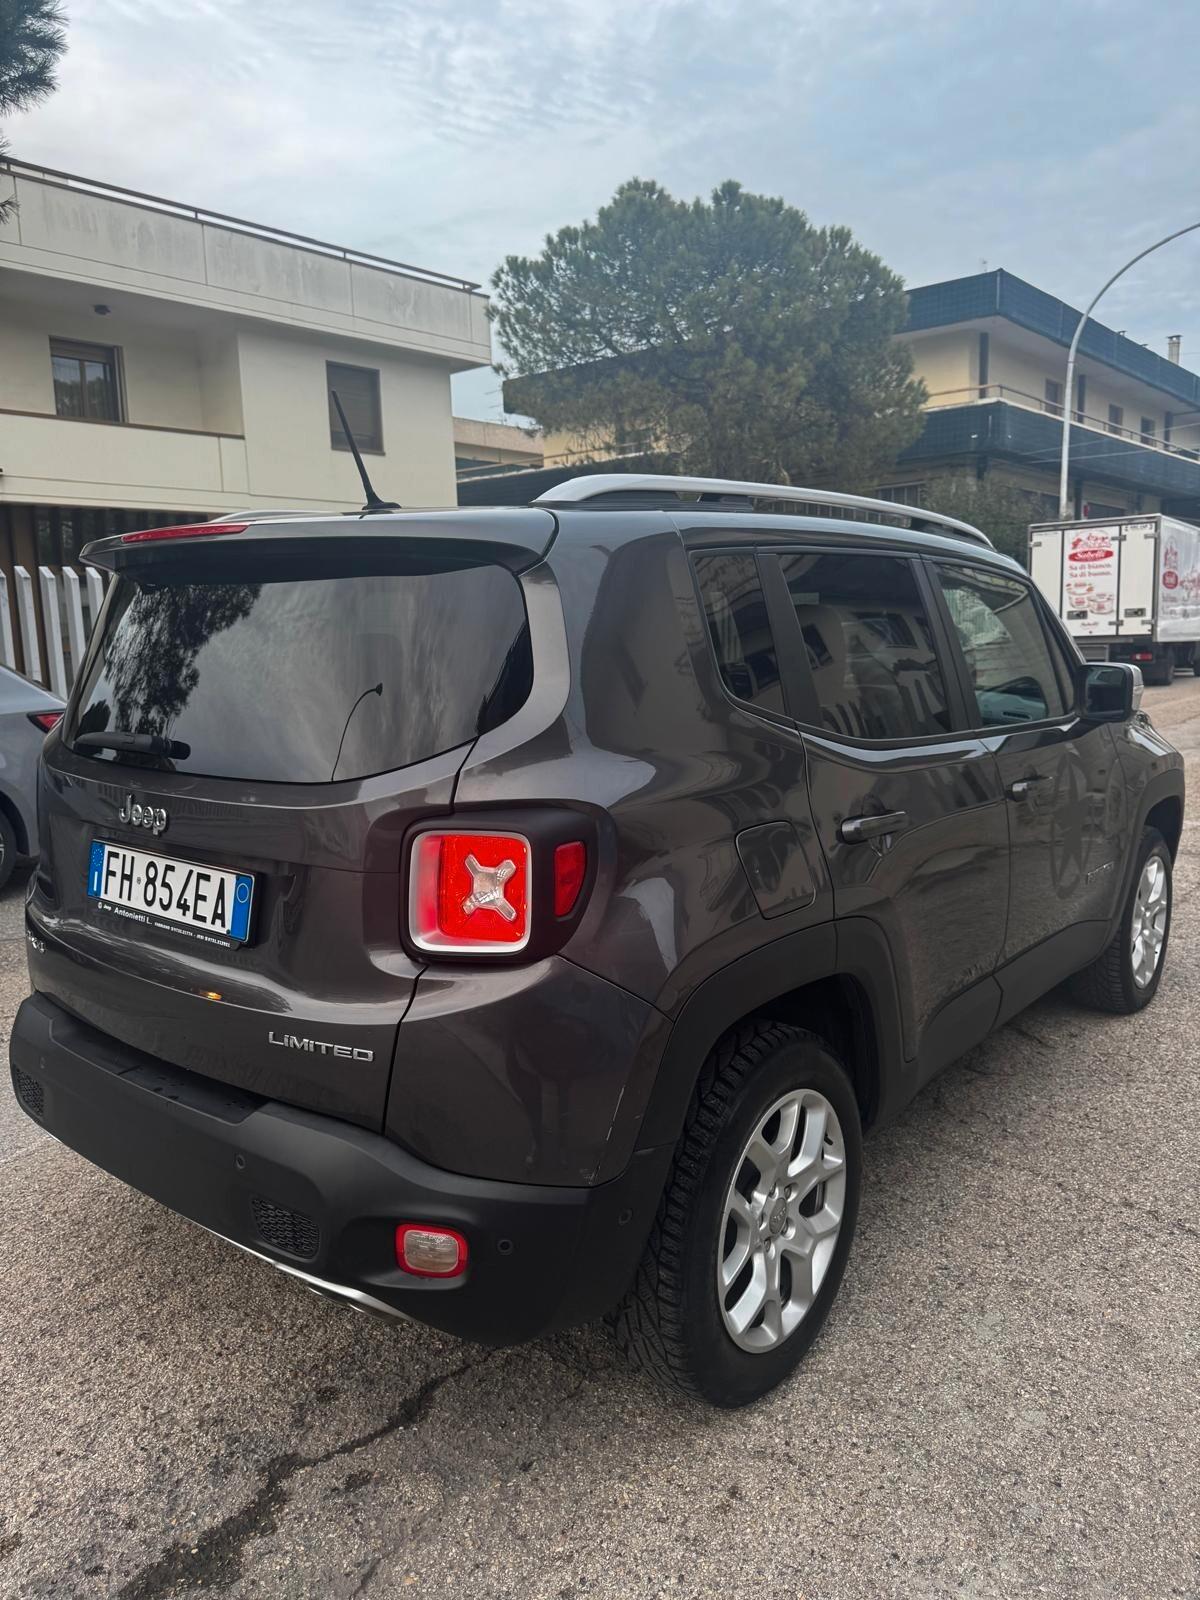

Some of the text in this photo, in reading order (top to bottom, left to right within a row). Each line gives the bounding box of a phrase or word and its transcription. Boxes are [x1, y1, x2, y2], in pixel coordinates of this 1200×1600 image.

[119, 794, 167, 835] Jeep
[114, 907, 145, 922] Antonietti
[268, 1031, 374, 1062] LIMITED
